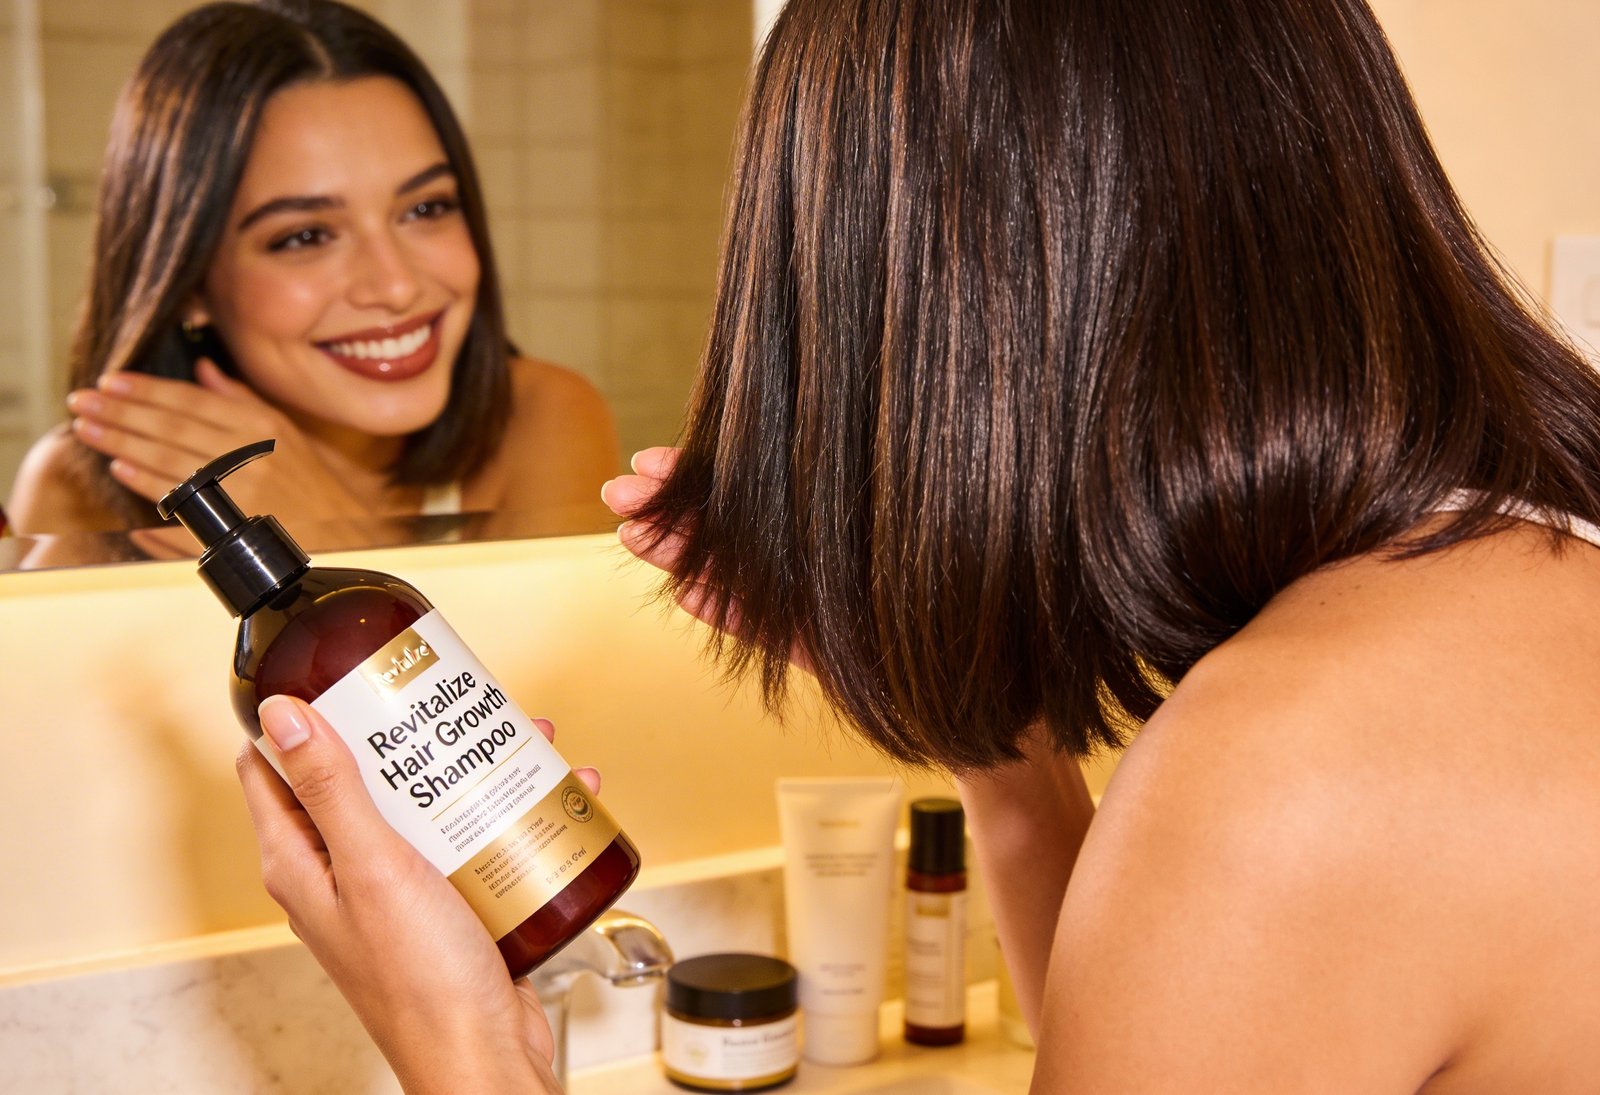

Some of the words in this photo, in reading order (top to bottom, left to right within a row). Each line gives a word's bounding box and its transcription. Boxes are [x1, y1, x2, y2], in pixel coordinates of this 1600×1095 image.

[367, 671, 476, 760] Revitalize
[380, 741, 435, 791] Hair
[435, 683, 508, 746] Growth
[410, 721, 516, 808] Shampoo
